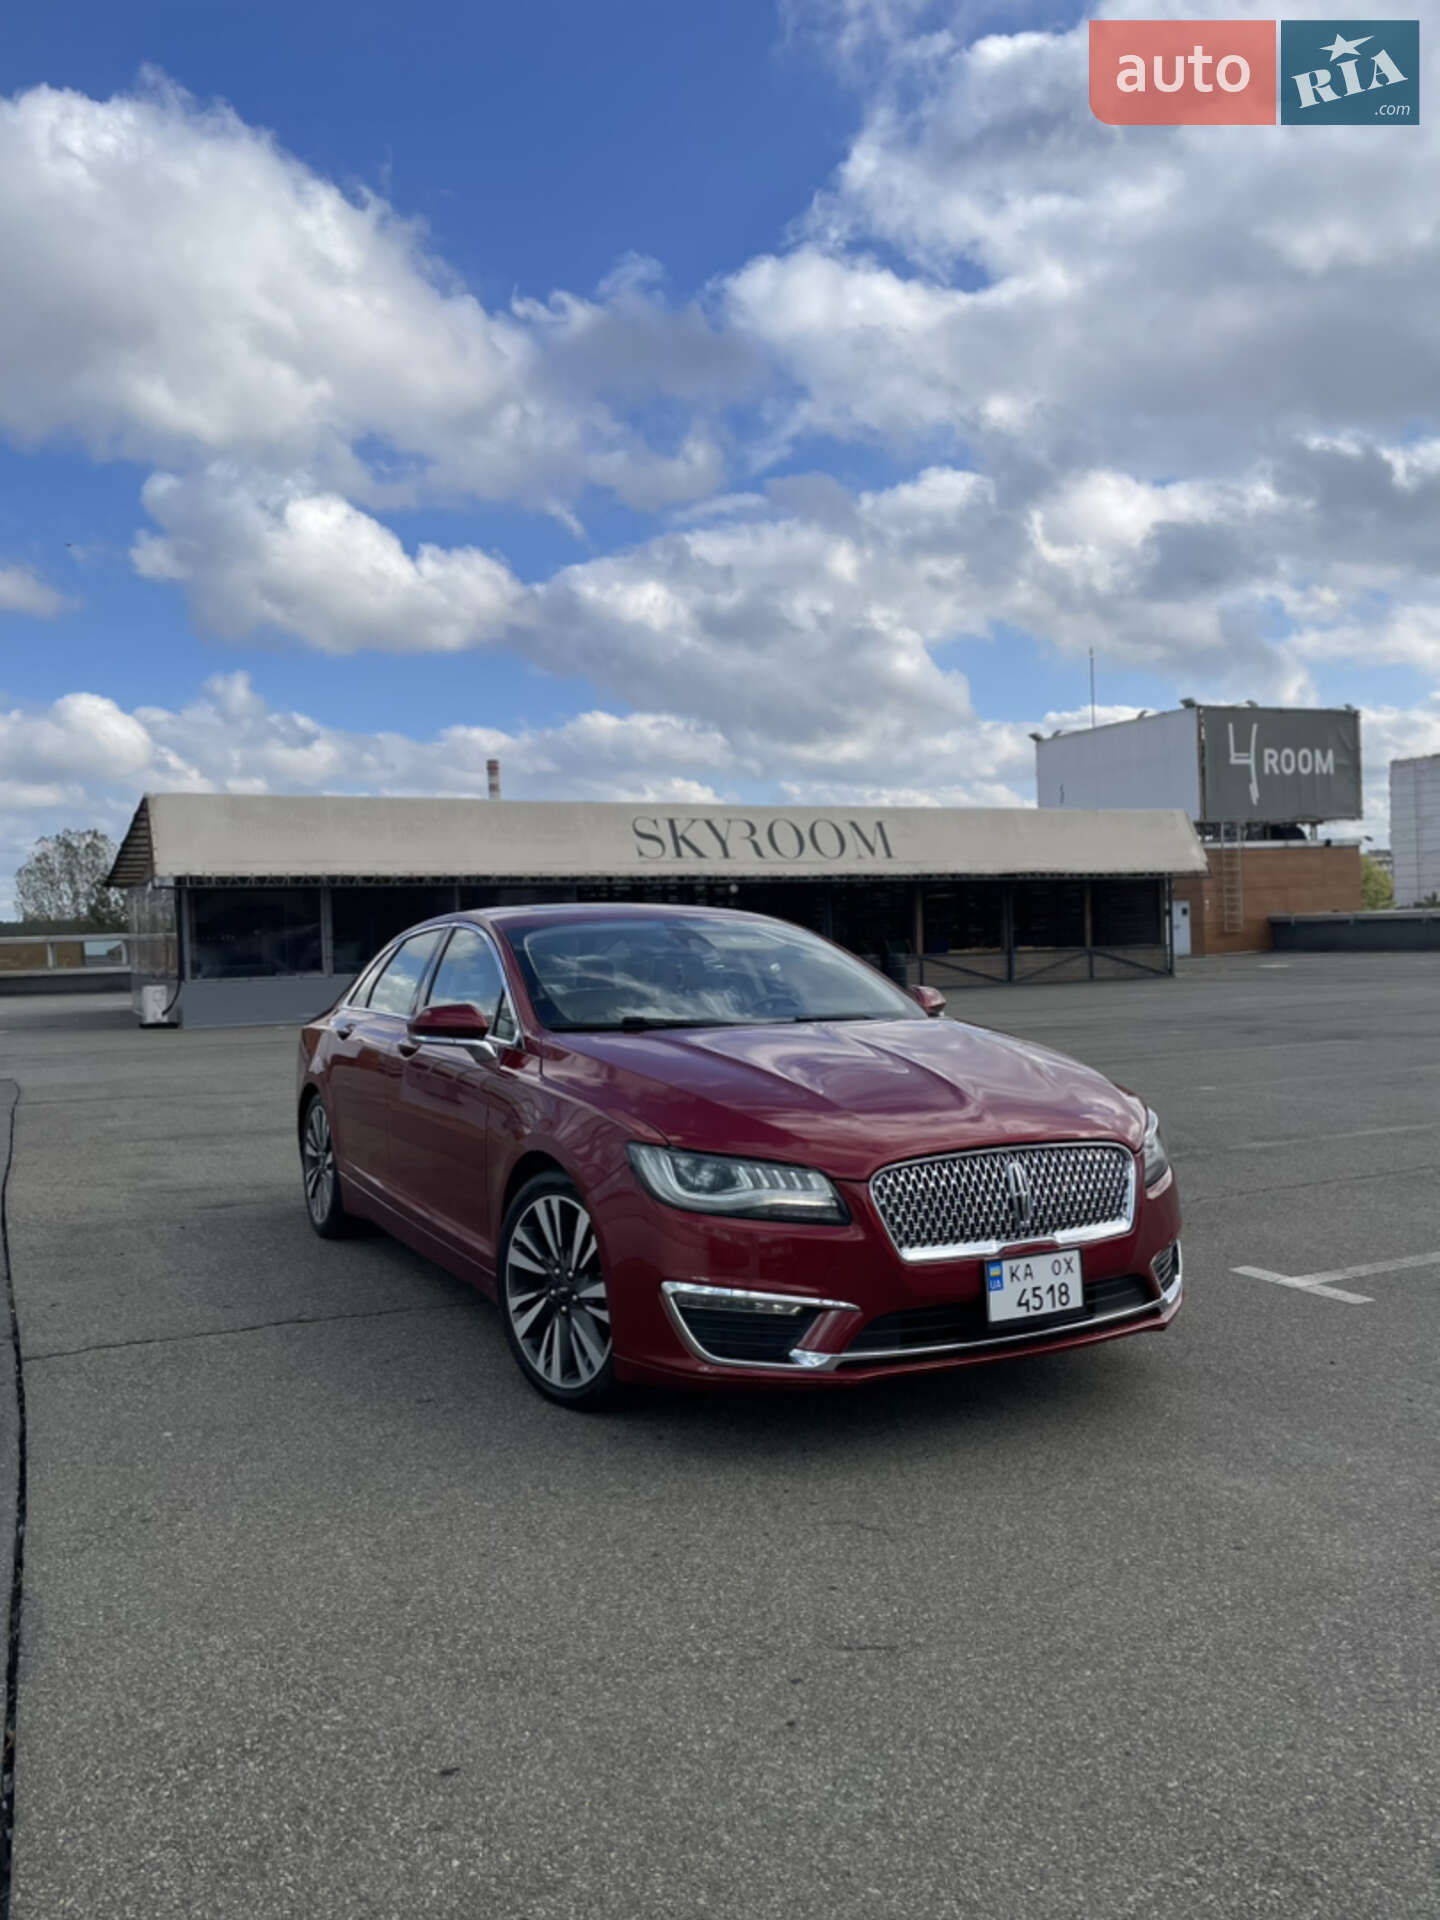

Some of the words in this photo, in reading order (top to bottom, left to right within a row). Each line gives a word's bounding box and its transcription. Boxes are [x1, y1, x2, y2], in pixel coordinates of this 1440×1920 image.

[1263, 747, 1335, 776] ROOM
[631, 815, 897, 861] SKYROOM
[1009, 1263, 1034, 1283] KA
[1016, 1282, 1071, 1313] 4518
